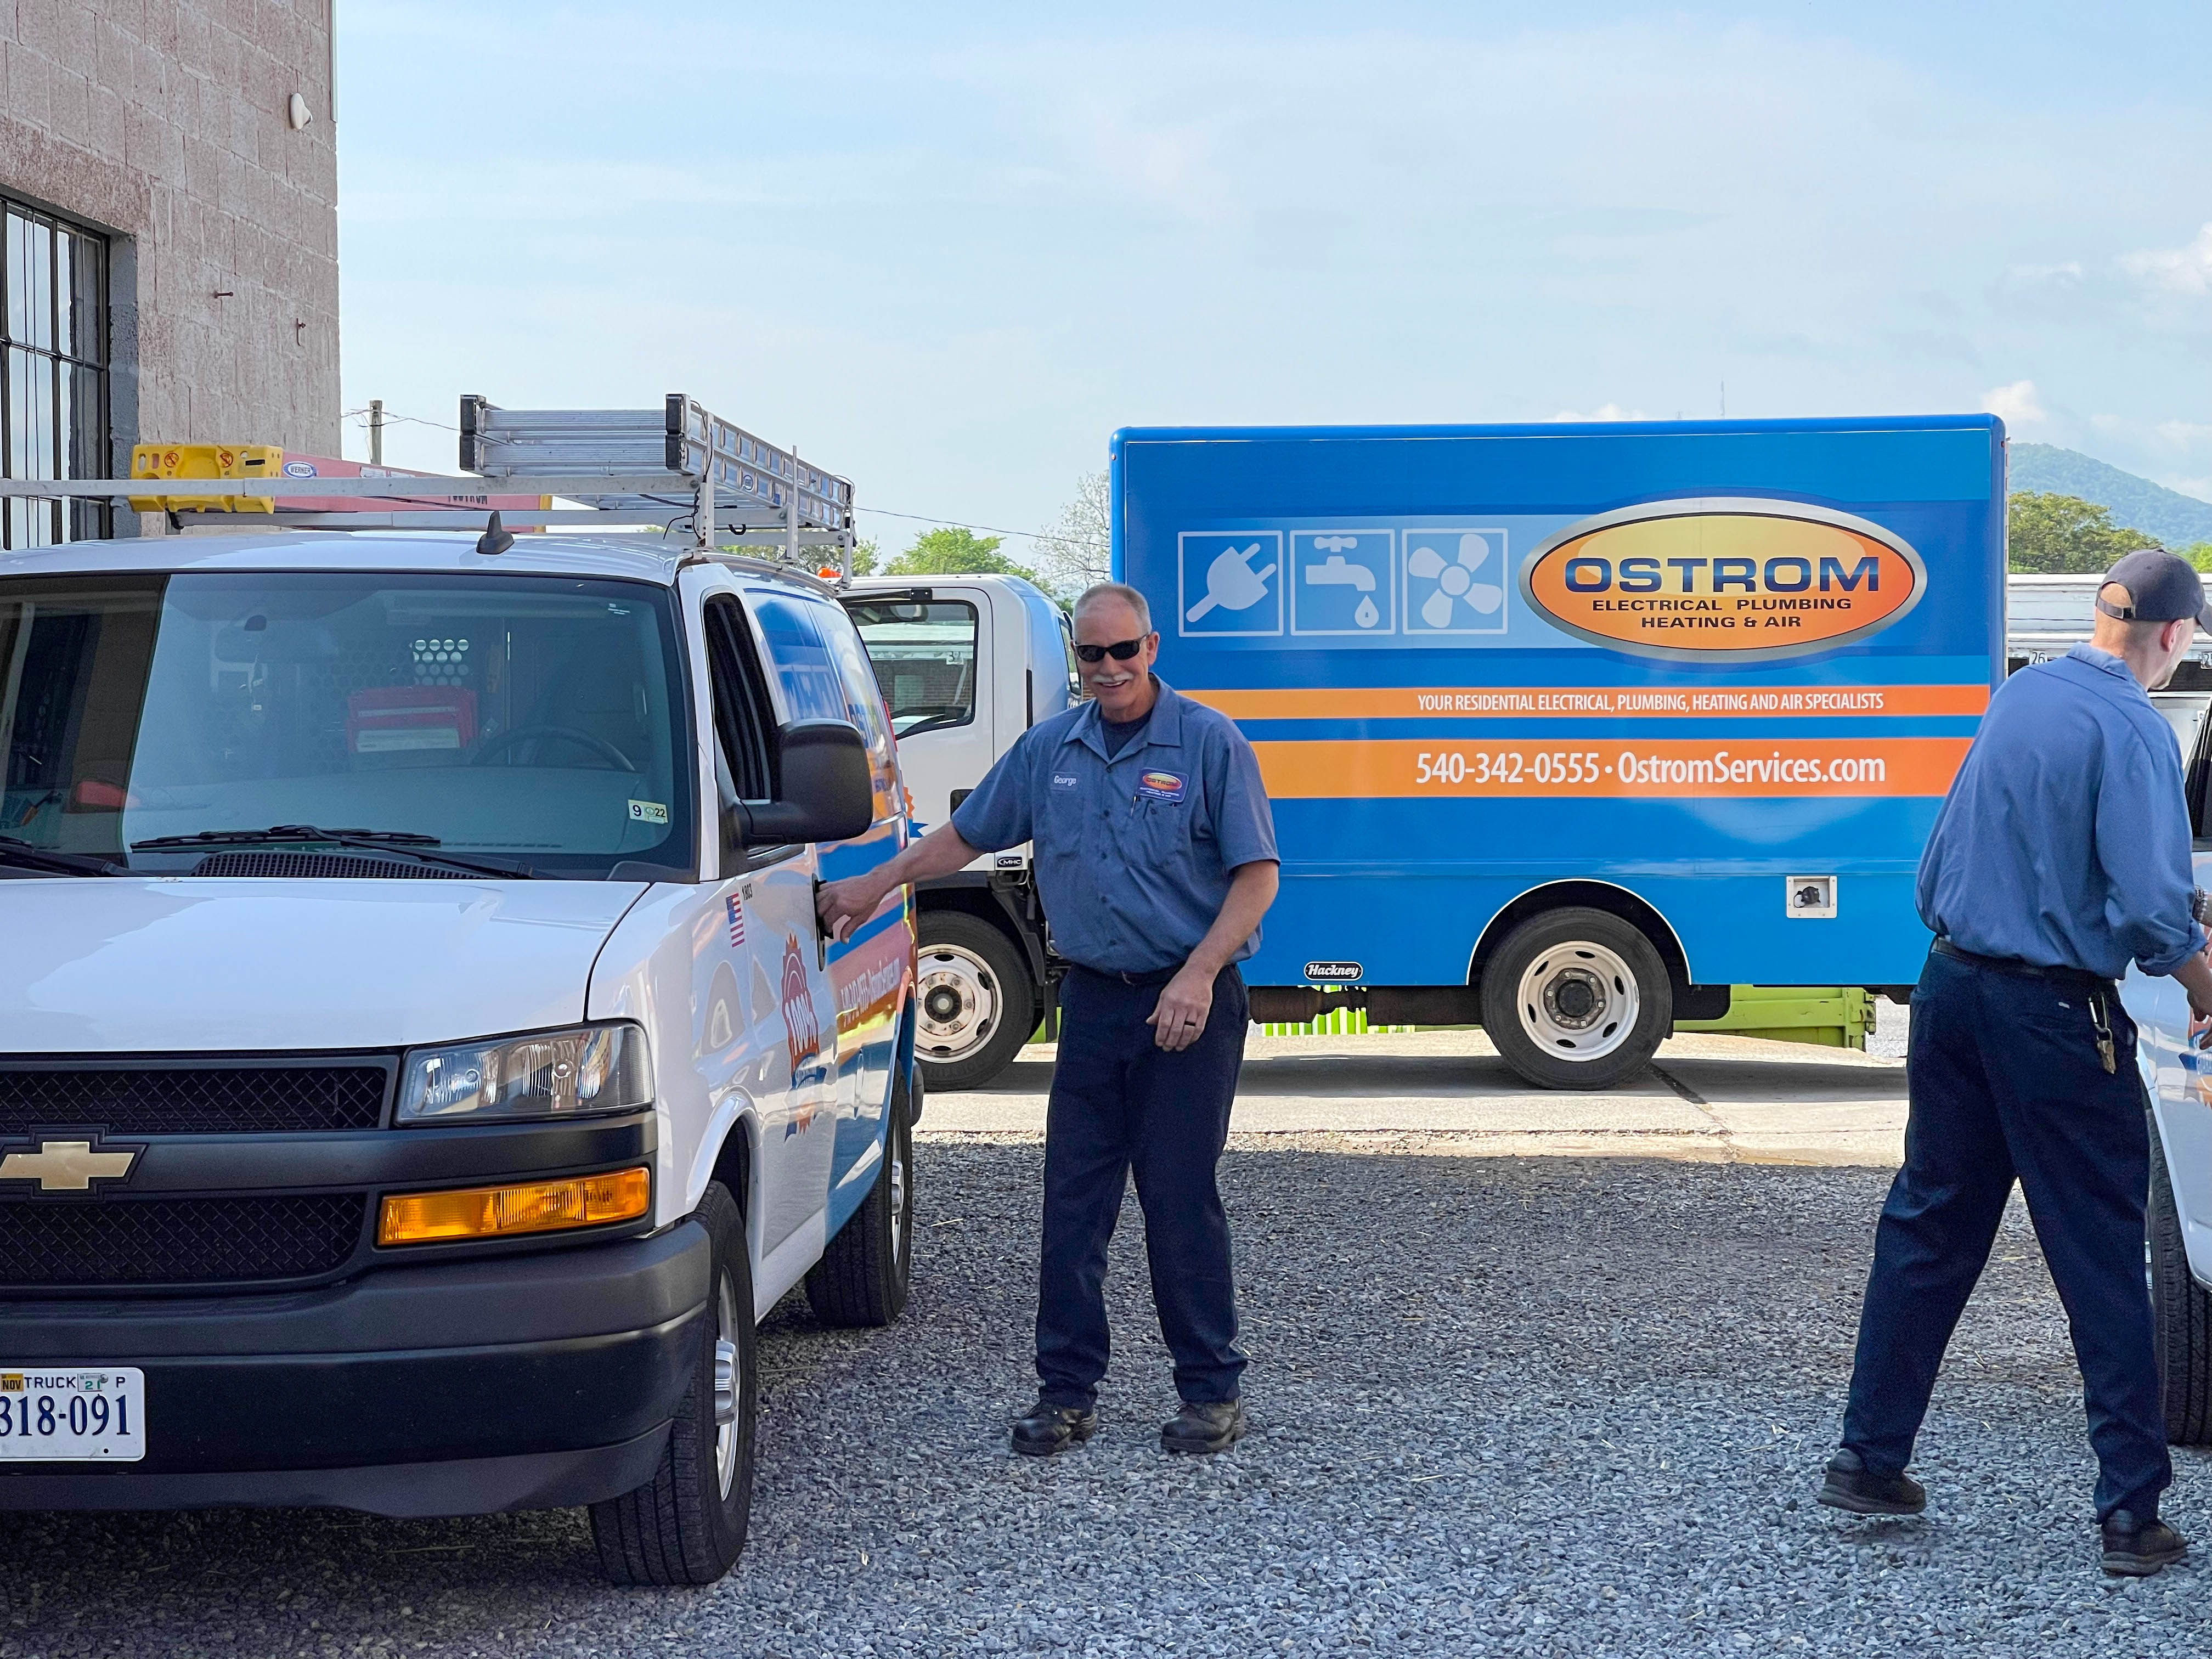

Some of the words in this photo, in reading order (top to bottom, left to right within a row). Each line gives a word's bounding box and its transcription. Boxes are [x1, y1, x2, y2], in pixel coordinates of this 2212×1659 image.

[290, 466, 311, 475] WERNER
[1565, 557, 1879, 592] OSTROM
[1593, 600, 1723, 611] ELECTRICAL
[1737, 598, 1852, 610] PLUMBING
[1641, 617, 1735, 628] HEATING
[1743, 617, 1757, 628] &
[1764, 616, 1801, 628] AIR
[2032, 652, 2046, 665] 26
[2203, 653, 2212, 668] 2
[1418, 695, 1453, 711] YOUR
[1458, 695, 1536, 711] RESIDENTIAL
[1538, 695, 1615, 712] ELECTRICAL,
[1617, 694, 1690, 712] PLUMBING,
[1692, 694, 1748, 710] HEATING
[1750, 694, 1778, 710] AND
[1781, 693, 1803, 709] AIR
[1805, 693, 1884, 709] SPECIALISTS
[1415, 752, 1600, 784] 540-342-0555
[1617, 751, 1886, 784] OstromServices.com
[1054, 775, 1076, 786] George
[633, 805, 642, 817] 9
[654, 808, 666, 817] 22
[1308, 964, 1359, 978] Hackney
[2, 1379, 21, 1390] NOV
[24, 1376, 77, 1389] TRUCK
[85, 1379, 100, 1390] 21
[116, 1376, 126, 1389] P
[0, 1394, 131, 1437] 318-091
